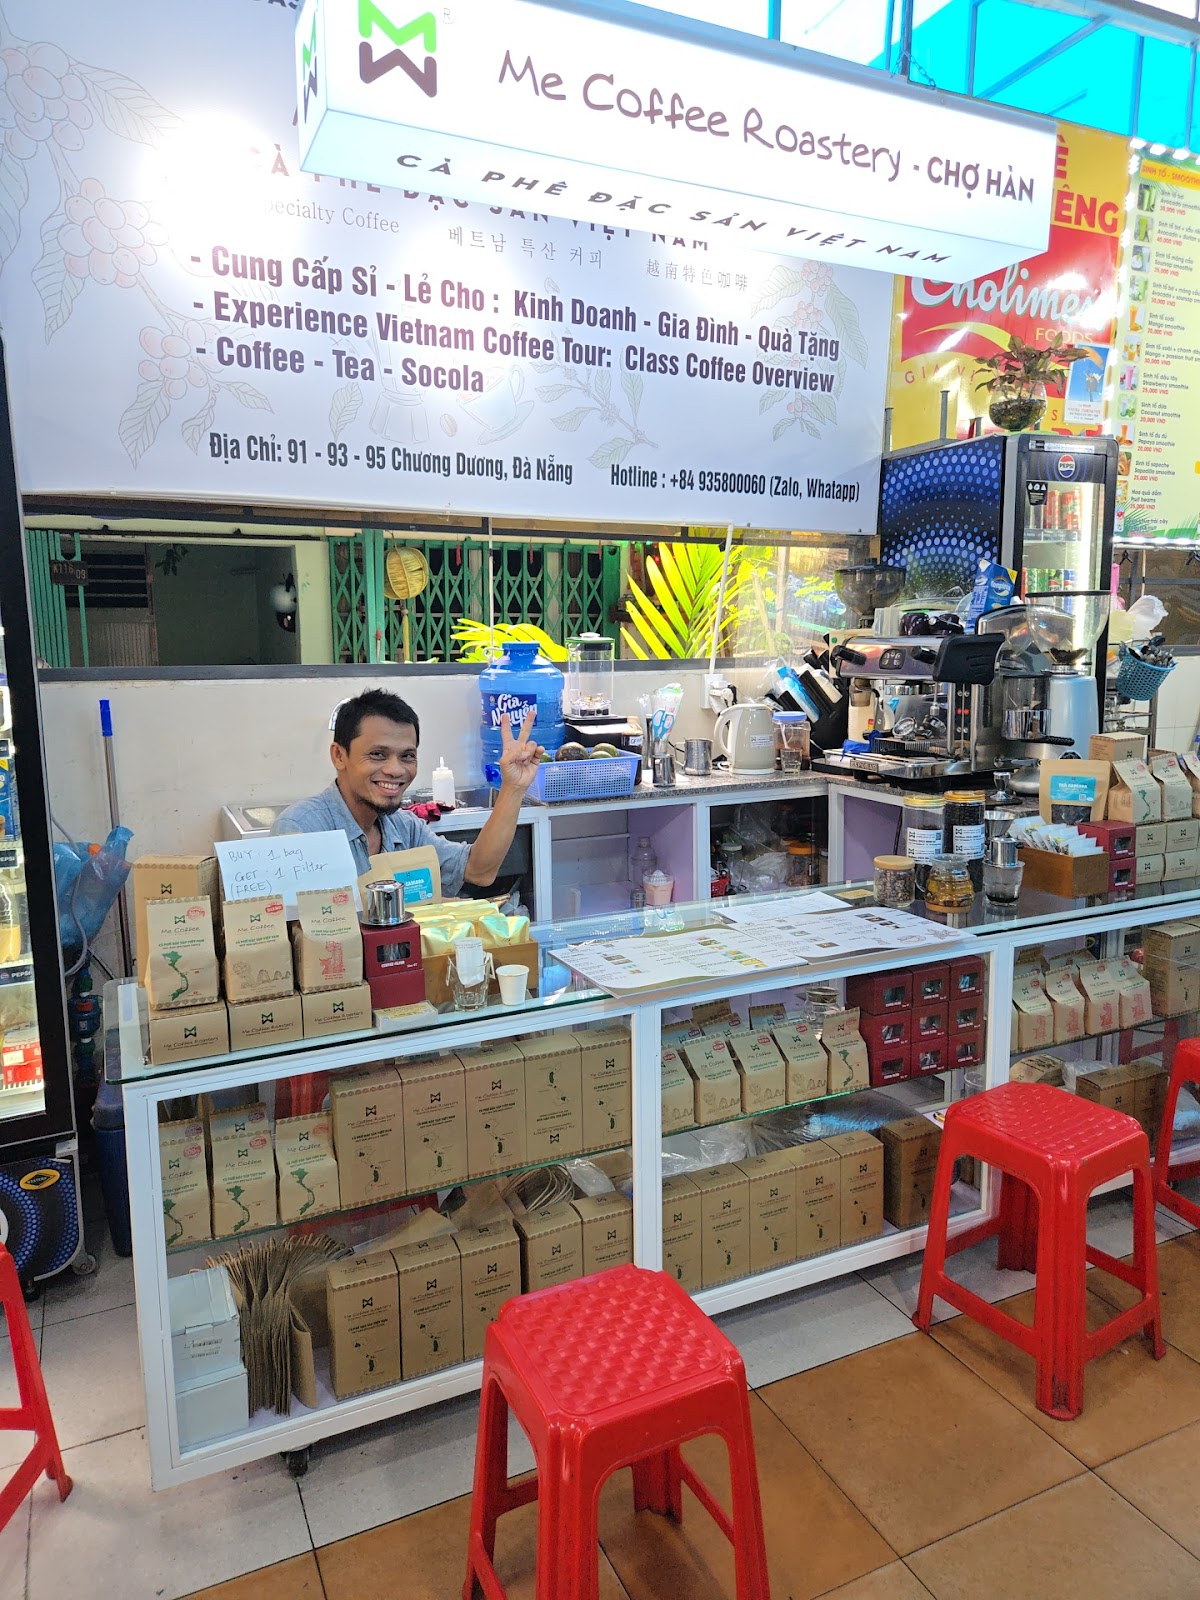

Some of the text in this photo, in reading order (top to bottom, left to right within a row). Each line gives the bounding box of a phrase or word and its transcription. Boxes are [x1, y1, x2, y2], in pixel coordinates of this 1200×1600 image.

[499, 50, 566, 100] Me
[582, 73, 730, 138] Coffee
[744, 107, 901, 182] Roastery
[927, 156, 980, 199] CHỢ
[986, 164, 1034, 203] HÀN
[341, 207, 400, 233] Coffee
[396, 154, 954, 265] CÀ PHÊ ĐẶC SẢN VIỆT NAM
[1053, 183, 1119, 233] ÊNG
[448, 225, 602, 269] 베트남 특산 커피
[646, 258, 749, 291] 越南特色咖啡
[211, 245, 283, 288] Cung
[292, 255, 342, 295] Cấp
[352, 264, 377, 297] Sỉ
[403, 272, 432, 304] Lẻ
[440, 280, 485, 312] Cho
[514, 289, 564, 323] Kinh
[571, 298, 637, 332] Doanh
[658, 311, 690, 340] Gia
[696, 313, 739, 346] Đình
[758, 324, 792, 352] Quà
[798, 330, 841, 362] Tặng
[213, 290, 368, 338] Experience
[376, 312, 475, 351] Vietnam
[483, 326, 555, 361] Coffee
[561, 335, 612, 368] Tour:
[625, 345, 679, 376] Class
[686, 353, 746, 383] Coffee
[752, 360, 835, 393] Overview
[216, 336, 305, 374] Coffee
[331, 349, 376, 381] Tea
[401, 357, 484, 393] Socola
[209, 432, 241, 465] Địa
[246, 433, 282, 463] Chỉ:
[287, 439, 309, 464] 91
[327, 442, 348, 467] 93
[366, 445, 386, 470] 95
[391, 447, 451, 477] Chương
[456, 452, 508, 481] Dương,
[513, 456, 531, 480] Đà
[537, 454, 573, 485] Nẵng
[611, 464, 658, 488] Hotline
[670, 469, 695, 491] +84
[699, 471, 766, 495] 935800060
[769, 476, 803, 499] (Zalo,
[806, 478, 860, 502] Whatapp)
[498, 693, 523, 712] Gia
[234, 869, 258, 882] GET
[293, 861, 328, 880] Filter
[283, 848, 303, 861] bag
[174, 926, 201, 934] Coffee
